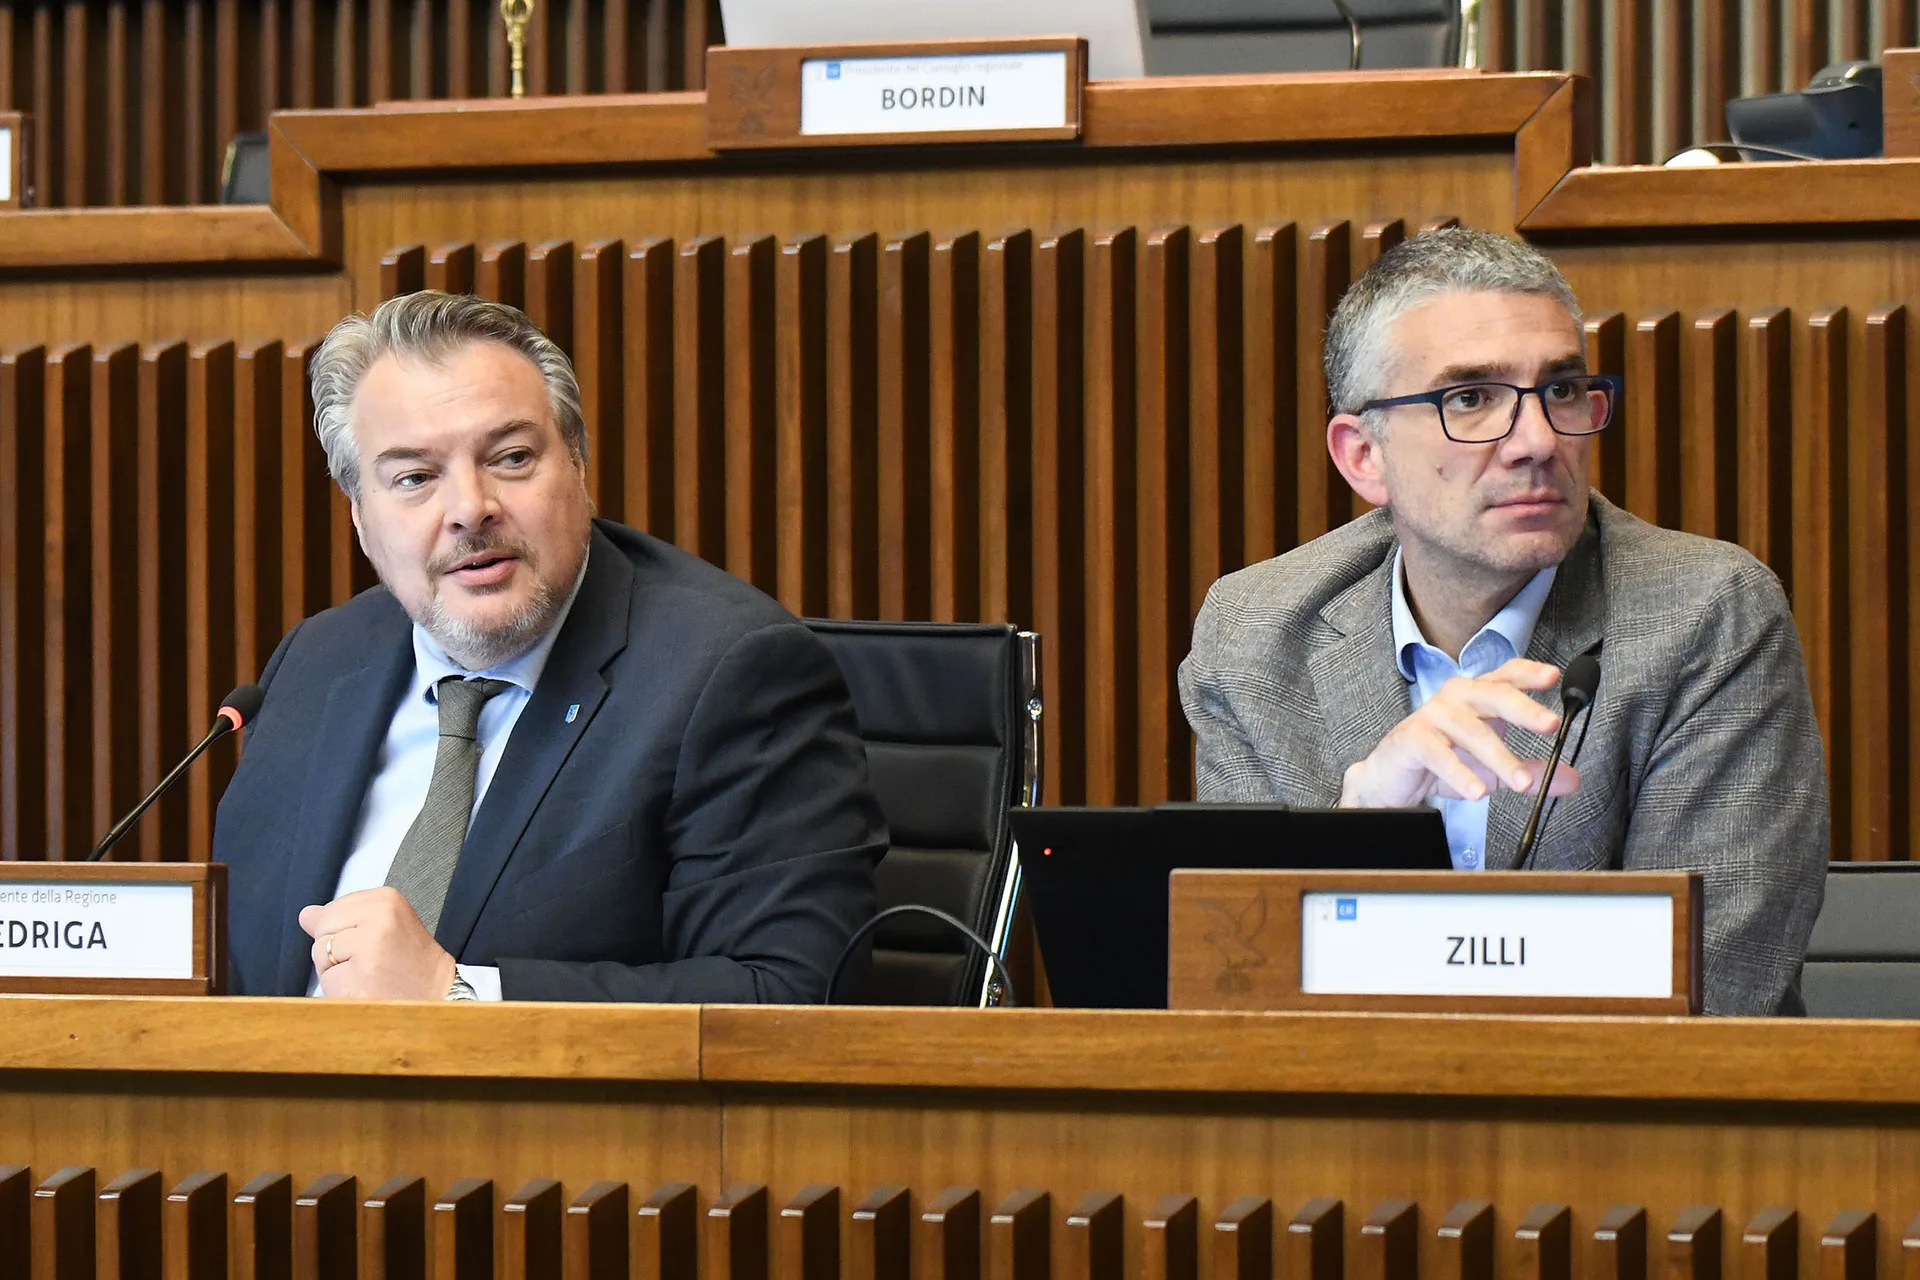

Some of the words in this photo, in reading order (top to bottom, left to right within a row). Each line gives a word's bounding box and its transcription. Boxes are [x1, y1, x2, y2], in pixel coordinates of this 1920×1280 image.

[973, 60, 1022, 74] regionale
[881, 85, 986, 110] BORDIN
[32, 889, 61, 904] della
[65, 890, 117, 908] Regione
[1446, 936, 1526, 966] ZILLI
